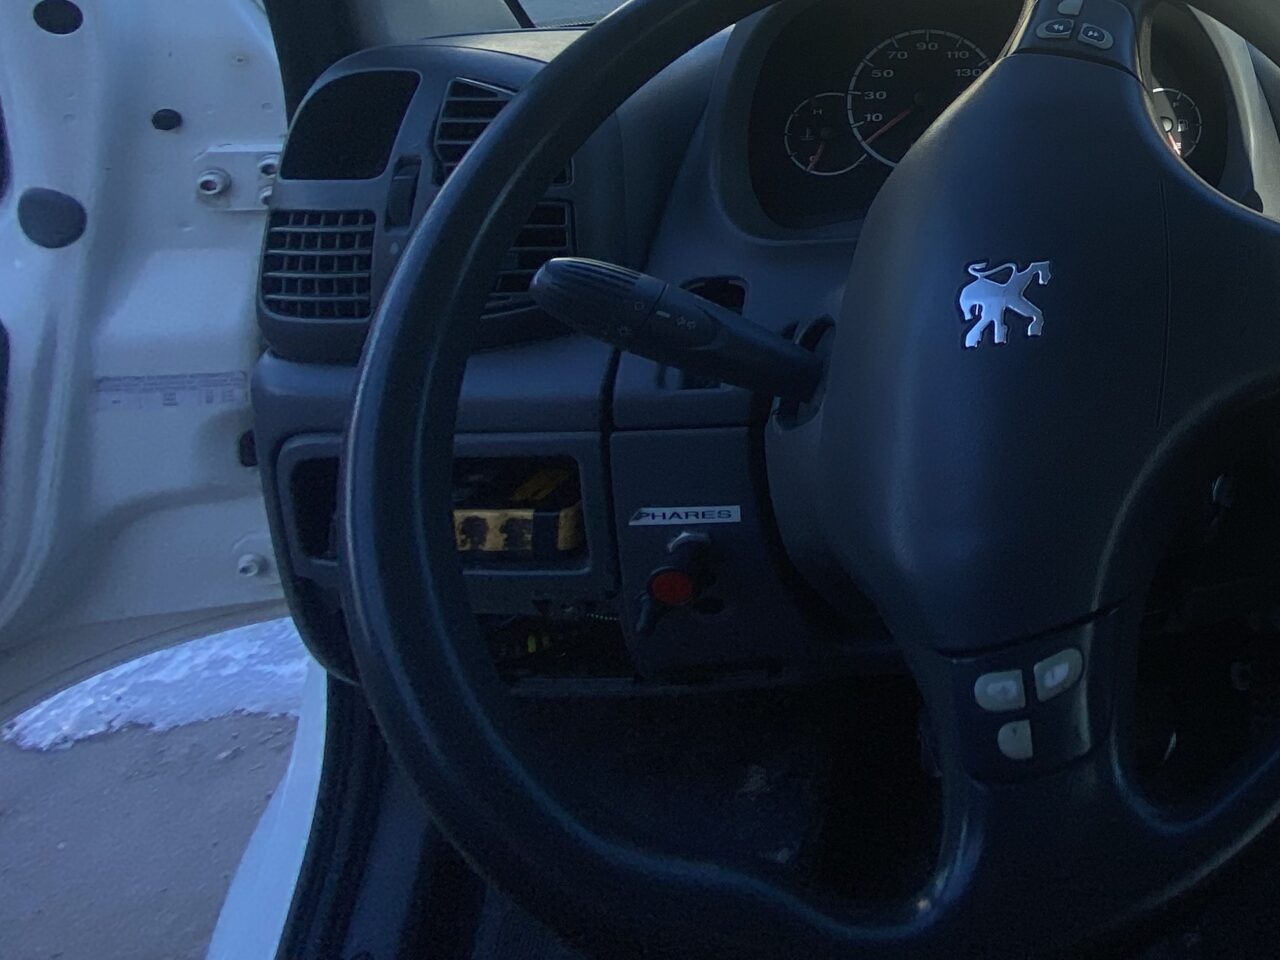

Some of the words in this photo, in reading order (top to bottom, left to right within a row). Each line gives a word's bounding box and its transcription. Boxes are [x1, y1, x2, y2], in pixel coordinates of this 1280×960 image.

[916, 41, 939, 51] 90
[887, 50, 908, 60] 70
[946, 50, 970, 59] 110
[871, 69, 895, 78] 50
[954, 68, 982, 78] 130
[863, 90, 887, 100] 30
[863, 113, 884, 122] 10
[635, 509, 732, 521] PHARES
